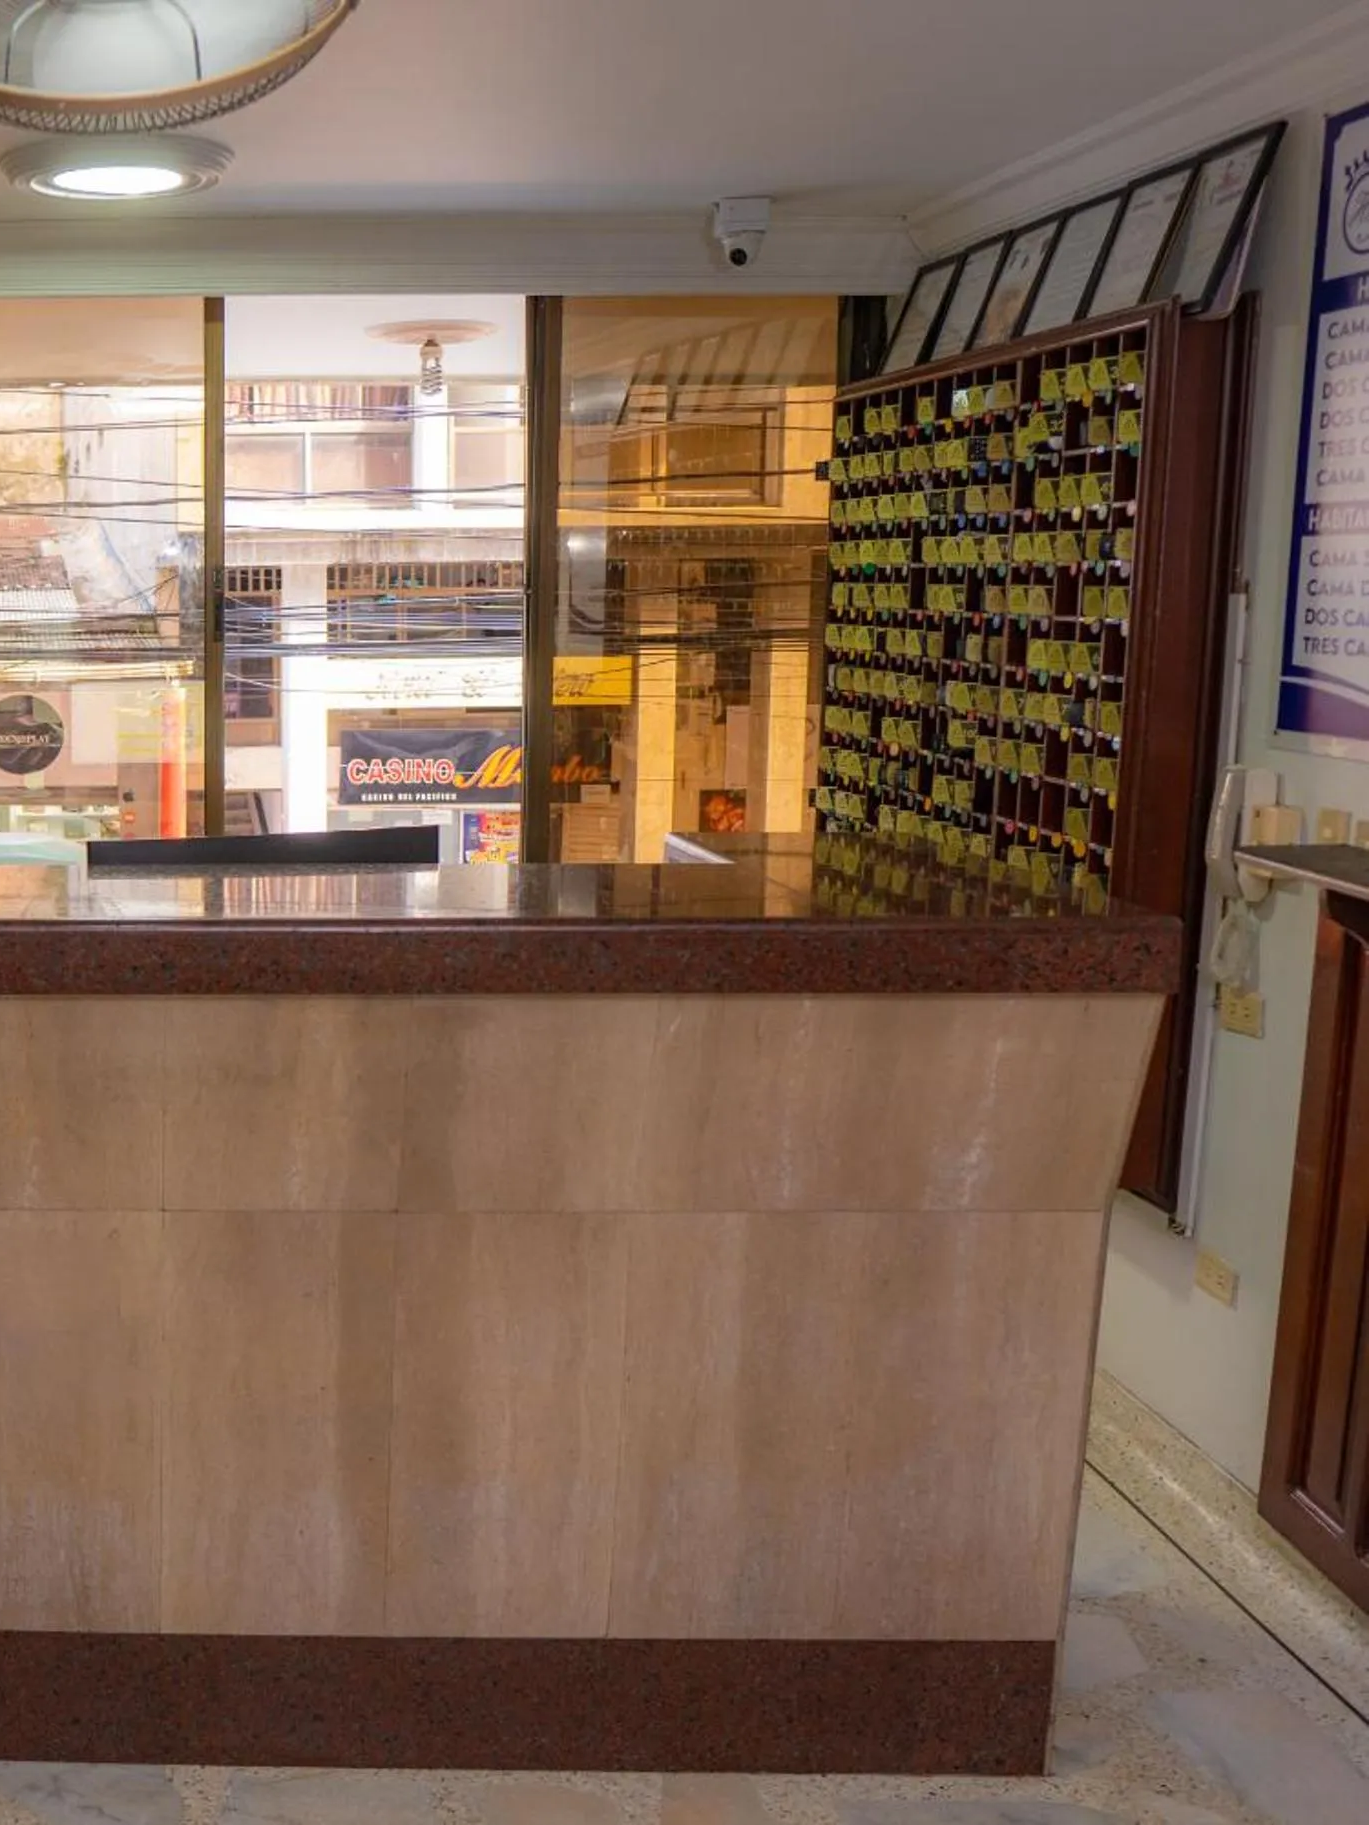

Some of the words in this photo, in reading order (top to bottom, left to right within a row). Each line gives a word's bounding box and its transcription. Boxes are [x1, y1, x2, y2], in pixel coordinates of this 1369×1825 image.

[1327, 318, 1369, 340] CAM
[1322, 379, 1359, 400] DOS
[1319, 409, 1355, 430] DOS
[1318, 438, 1357, 458] TRES
[1316, 467, 1365, 488] CAMA
[1309, 550, 1358, 568] CAMA
[1306, 579, 1355, 598] CAMA
[1304, 608, 1340, 627] DOS
[1303, 636, 1340, 656] TRES
[1344, 638, 1369, 657] CA
[346, 757, 458, 785] CASINO
